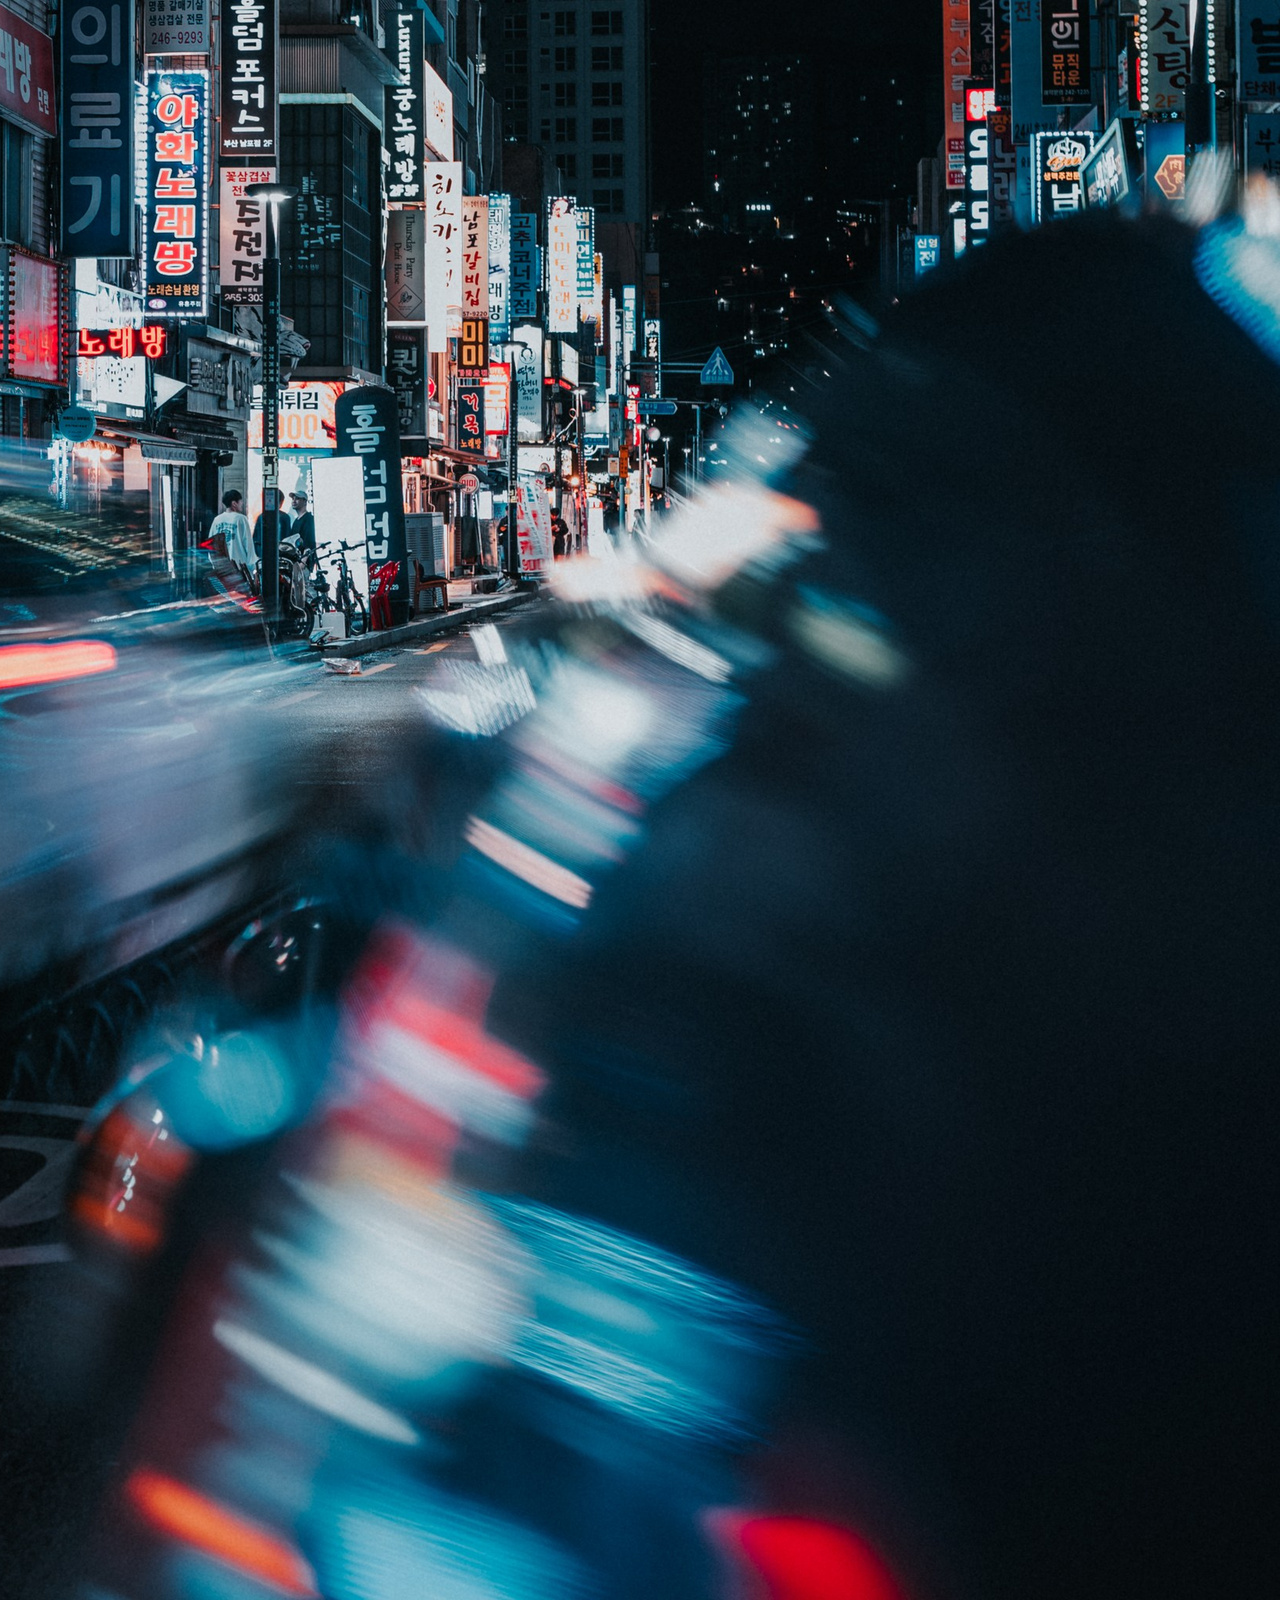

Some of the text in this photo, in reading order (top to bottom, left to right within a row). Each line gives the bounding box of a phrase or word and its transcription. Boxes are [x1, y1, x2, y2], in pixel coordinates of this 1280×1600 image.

[149, 0, 204, 12] 명품 갈매기살
[149, 13, 204, 27] 생삼겹살 전문
[151, 31, 204, 45] 246-9293
[397, 13, 413, 86] Luxury
[230, 59, 265, 134] 포커스
[1155, 93, 1177, 108] 2F
[152, 93, 200, 277] 야화노래방
[226, 171, 271, 183] 꽃삼겹살
[231, 199, 264, 283] 주전자
[404, 214, 416, 280] Thursday Party
[393, 242, 402, 286] Draft House
[512, 215, 532, 316] 고추코너주점
[147, 284, 200, 297] 노래손님 환영
[224, 293, 263, 303] 255-303
[77, 326, 166, 359] 노래방
[462, 320, 484, 367] 미미
[460, 438, 482, 450] 노래방
[346, 404, 390, 560] 홀덤펍
